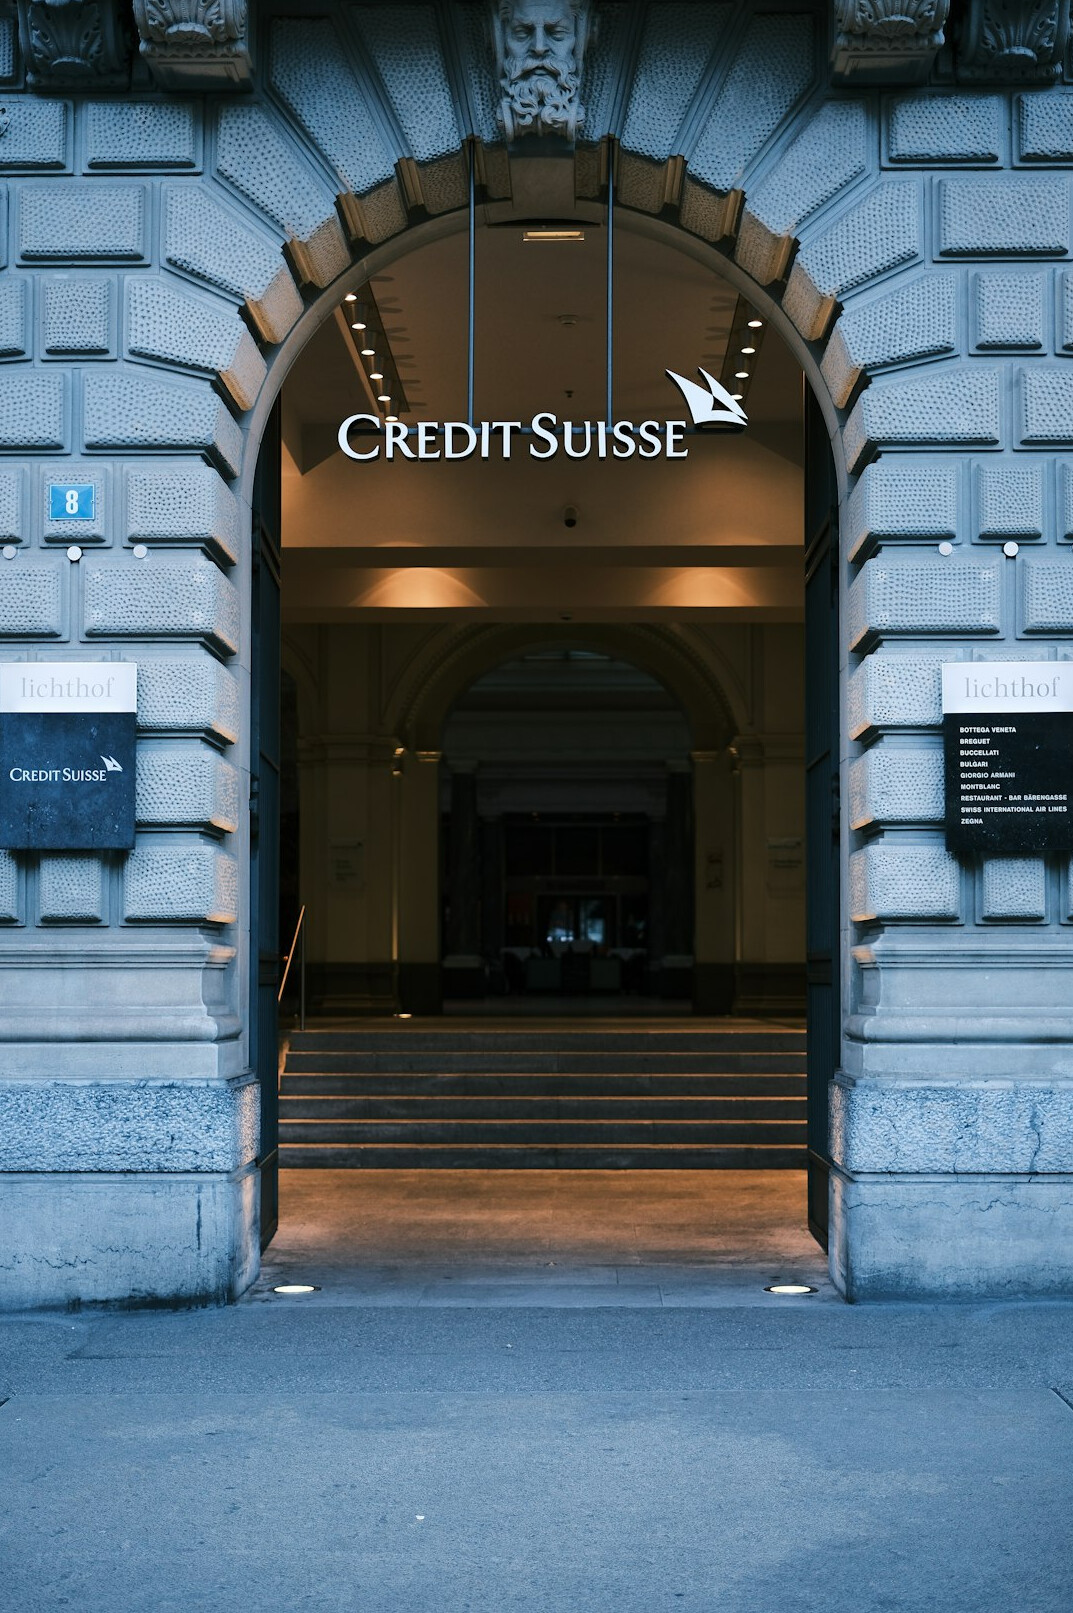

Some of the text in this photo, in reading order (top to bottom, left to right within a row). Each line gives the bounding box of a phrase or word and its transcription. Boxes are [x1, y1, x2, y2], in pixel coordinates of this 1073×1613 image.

[337, 412, 689, 460] CREDIT SUISSE
[65, 489, 79, 515] 8
[20, 677, 115, 698] lichthof
[964, 676, 1061, 698] lichthof
[9, 767, 107, 782] CREDIT SUISSE
[1023, 793, 1068, 801] BÄRENGASSE
